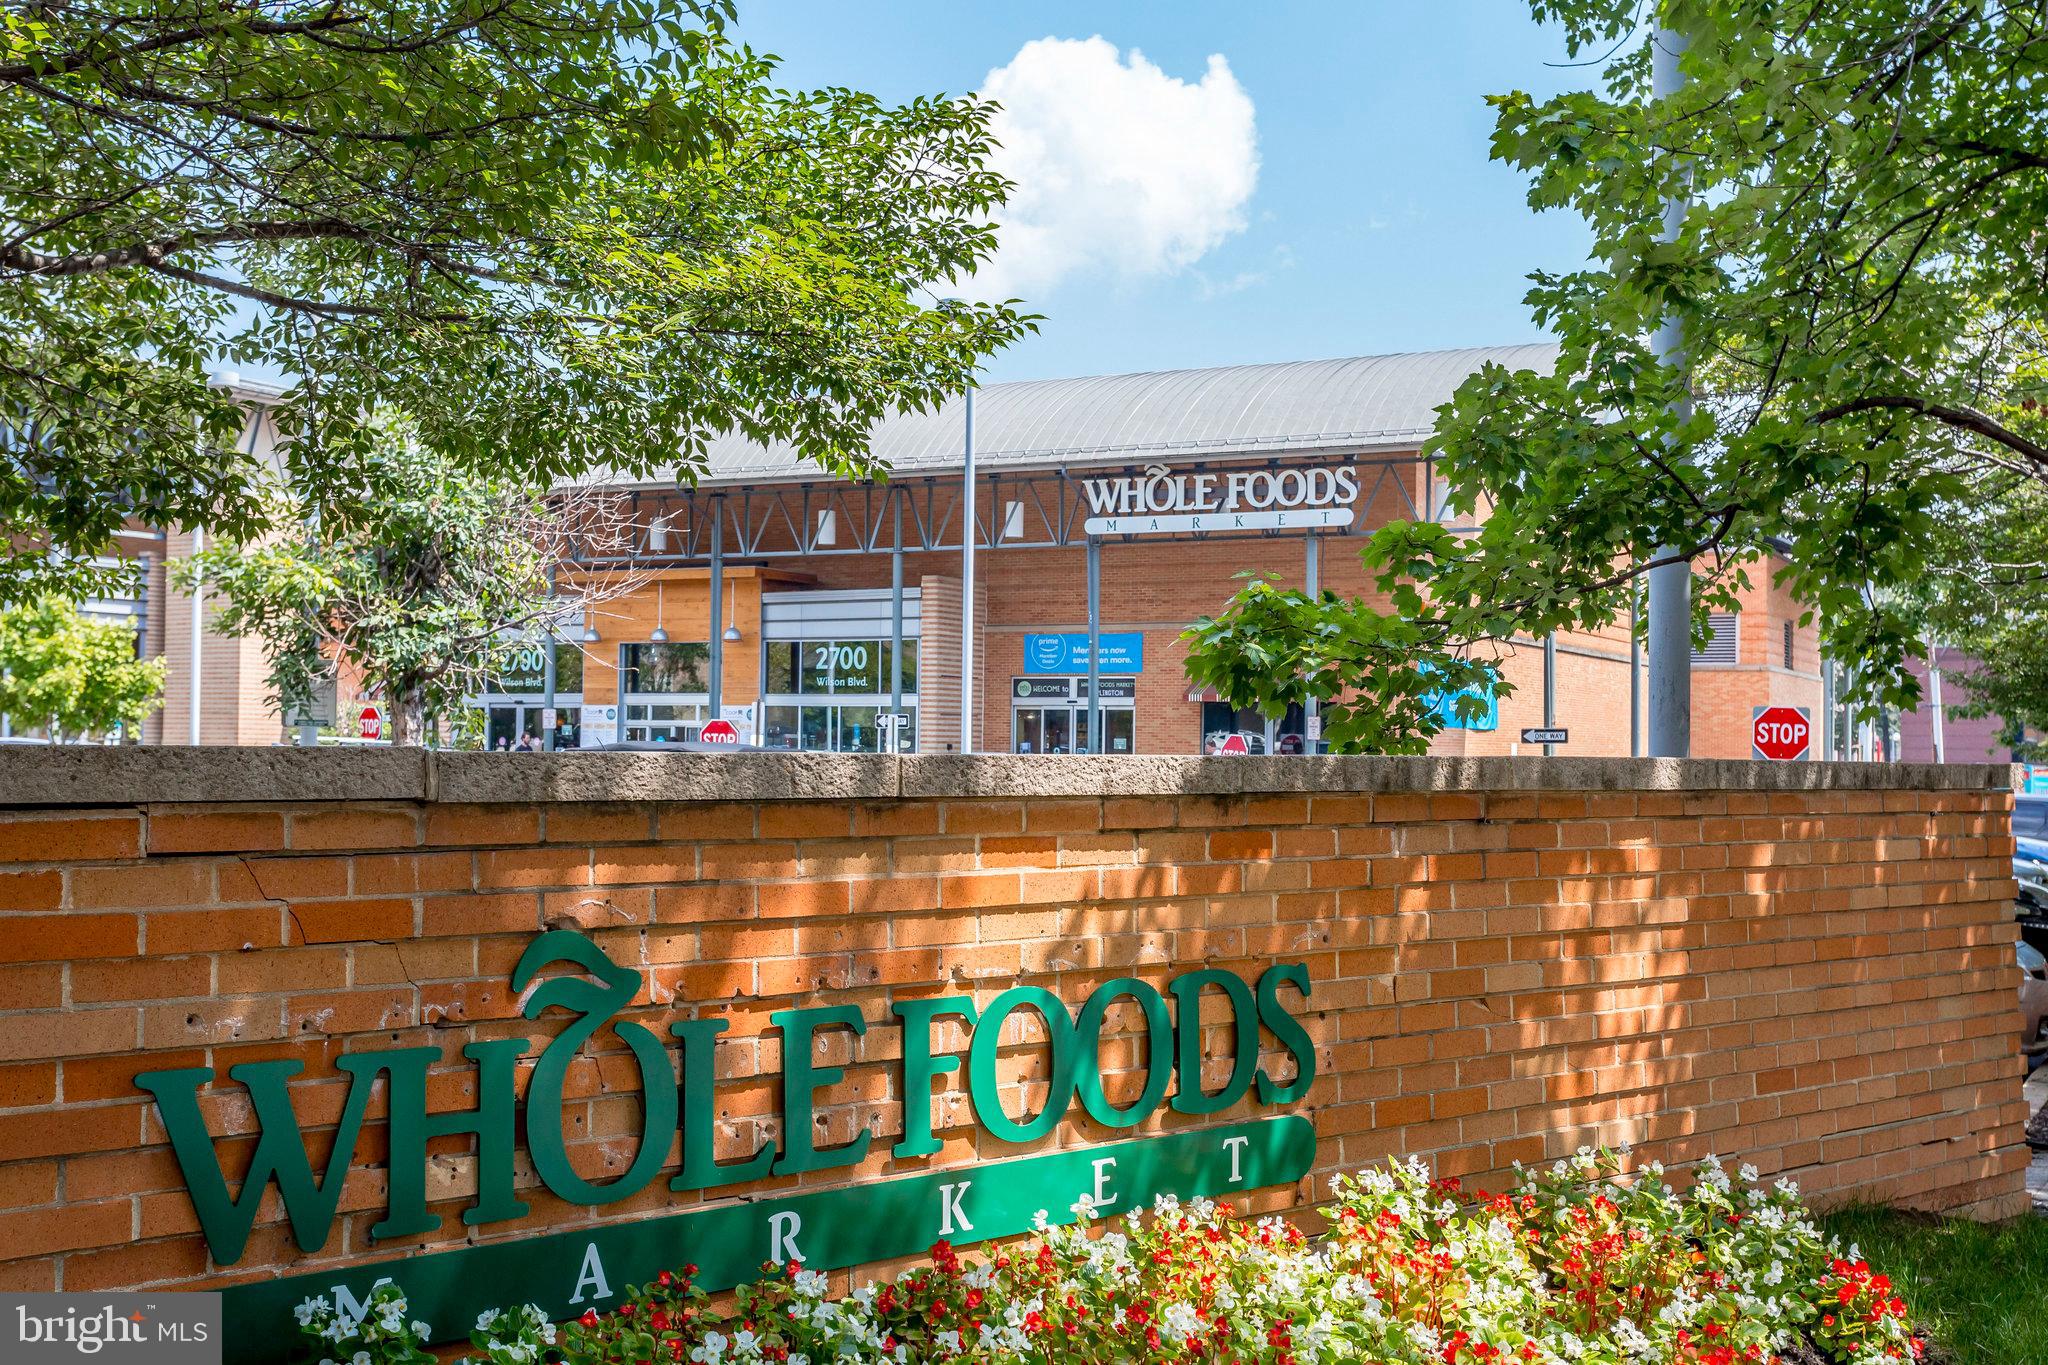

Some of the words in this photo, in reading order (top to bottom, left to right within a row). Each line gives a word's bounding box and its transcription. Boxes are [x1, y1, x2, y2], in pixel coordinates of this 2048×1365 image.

[1082, 464, 1218, 514] WHOLE
[1227, 466, 1359, 509] FOODS
[1106, 511, 1330, 532] MARKET
[1038, 637, 1059, 646] prime
[815, 646, 868, 670] 2700
[525, 676, 543, 687] Blvd.
[816, 677, 846, 687] Wilson
[847, 677, 868, 687] Blvd.
[1099, 689, 1124, 697] LINGTON
[360, 718, 380, 734] STOP
[1757, 723, 1806, 744] STOP
[1534, 732, 1549, 740] ONE
[134, 930, 873, 1266] WHOLE
[892, 963, 1315, 1159] FOODS
